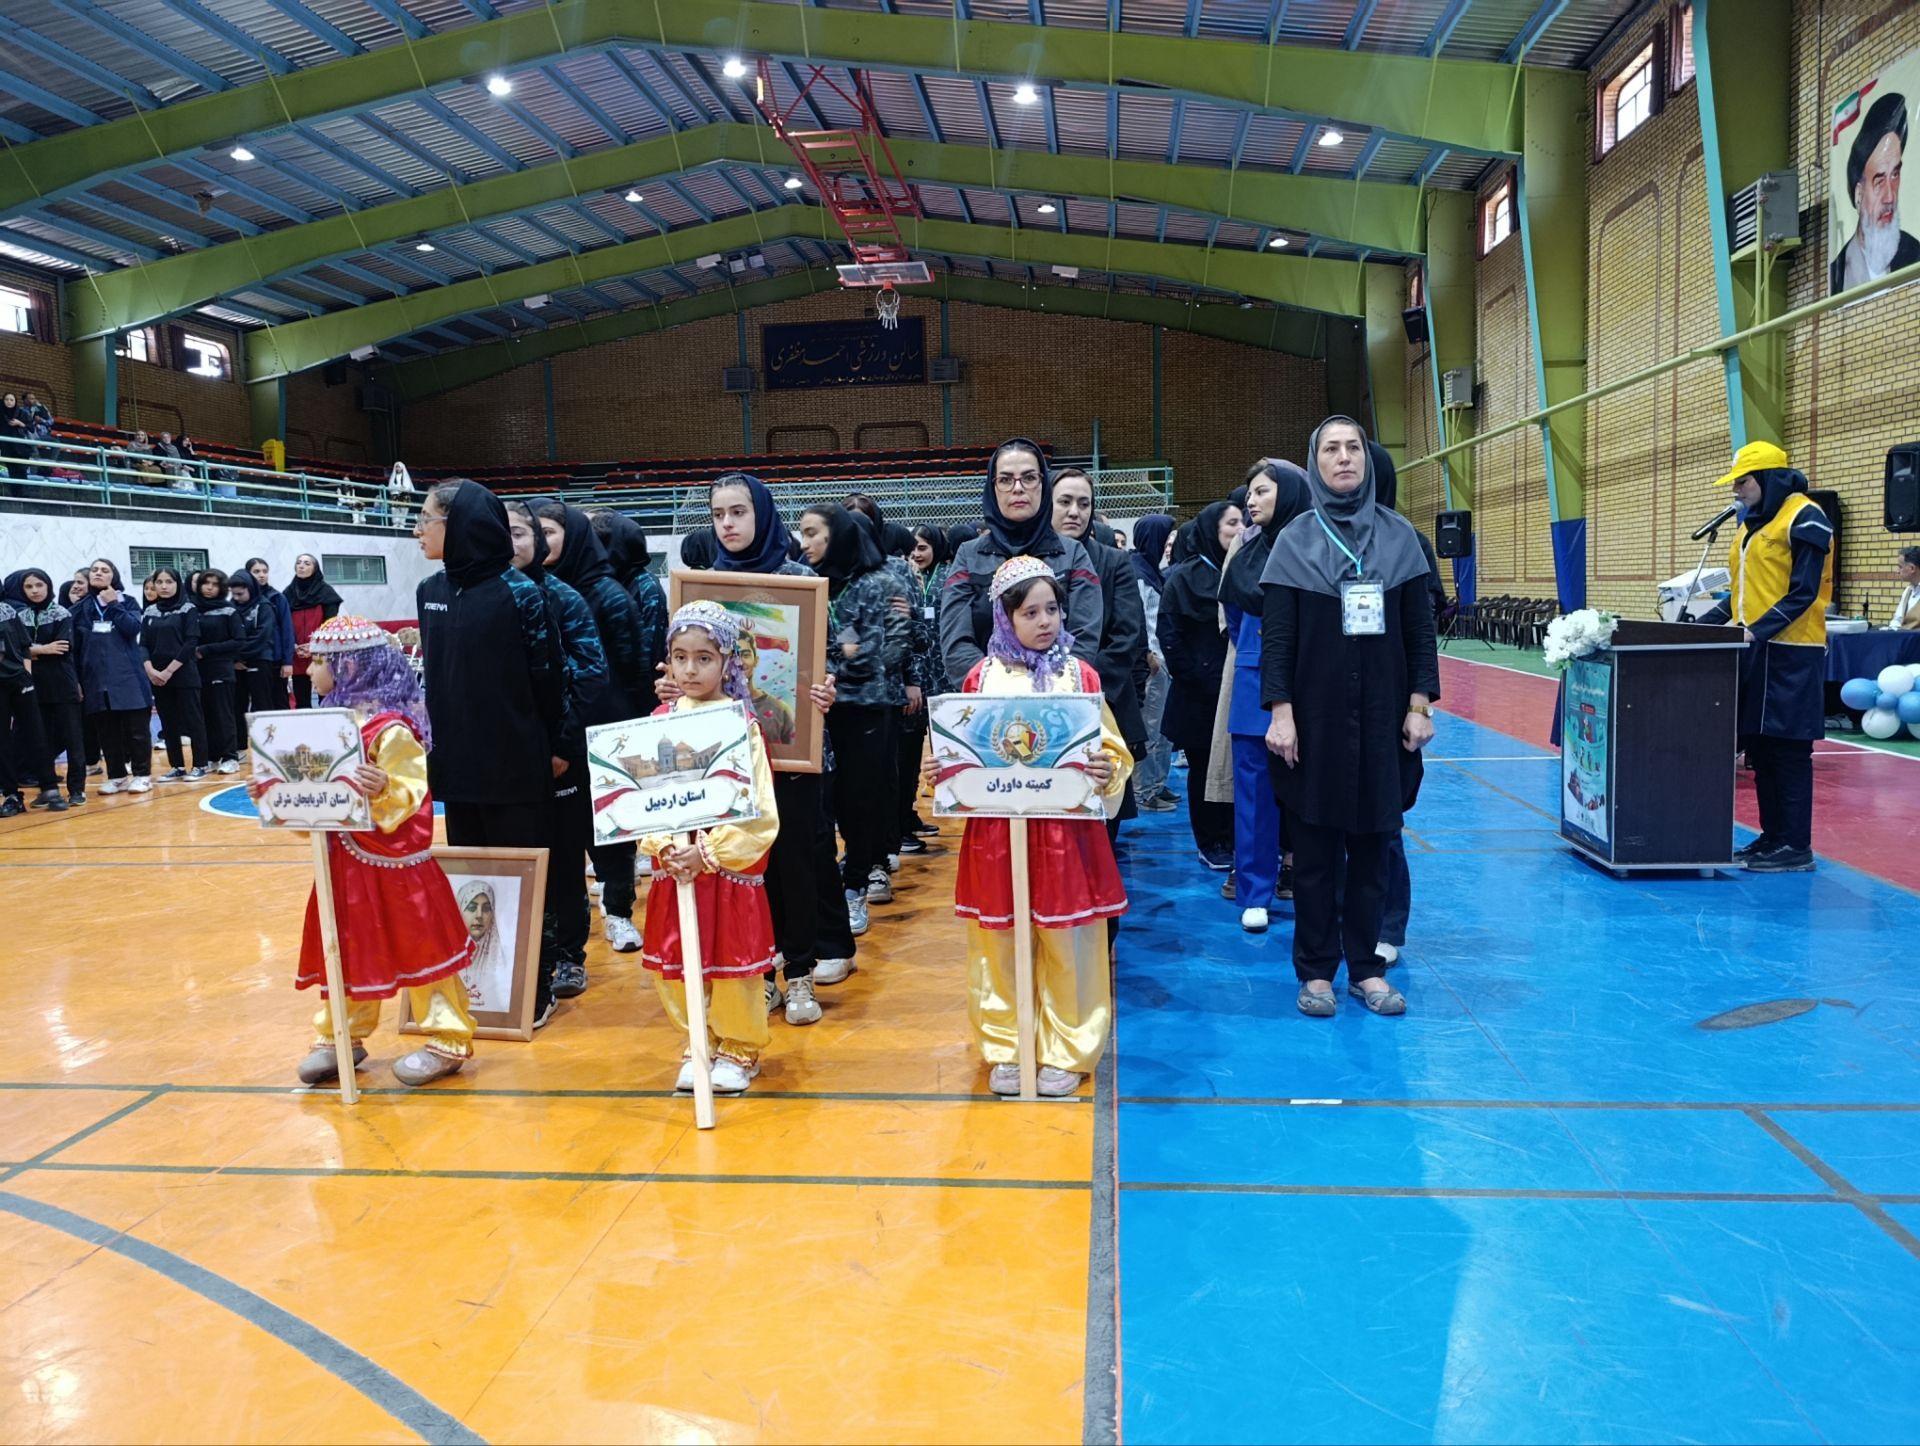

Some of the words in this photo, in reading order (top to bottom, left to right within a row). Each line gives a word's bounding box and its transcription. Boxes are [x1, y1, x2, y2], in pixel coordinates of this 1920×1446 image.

[986, 777, 1023, 793] داوران
[1025, 778, 1053, 793] کمیته
[273, 792, 292, 808] شرقی
[293, 792, 328, 808] آذربایجان
[329, 793, 350, 808] استان
[644, 794, 677, 812] اردبیل
[679, 788, 706, 807] استان
